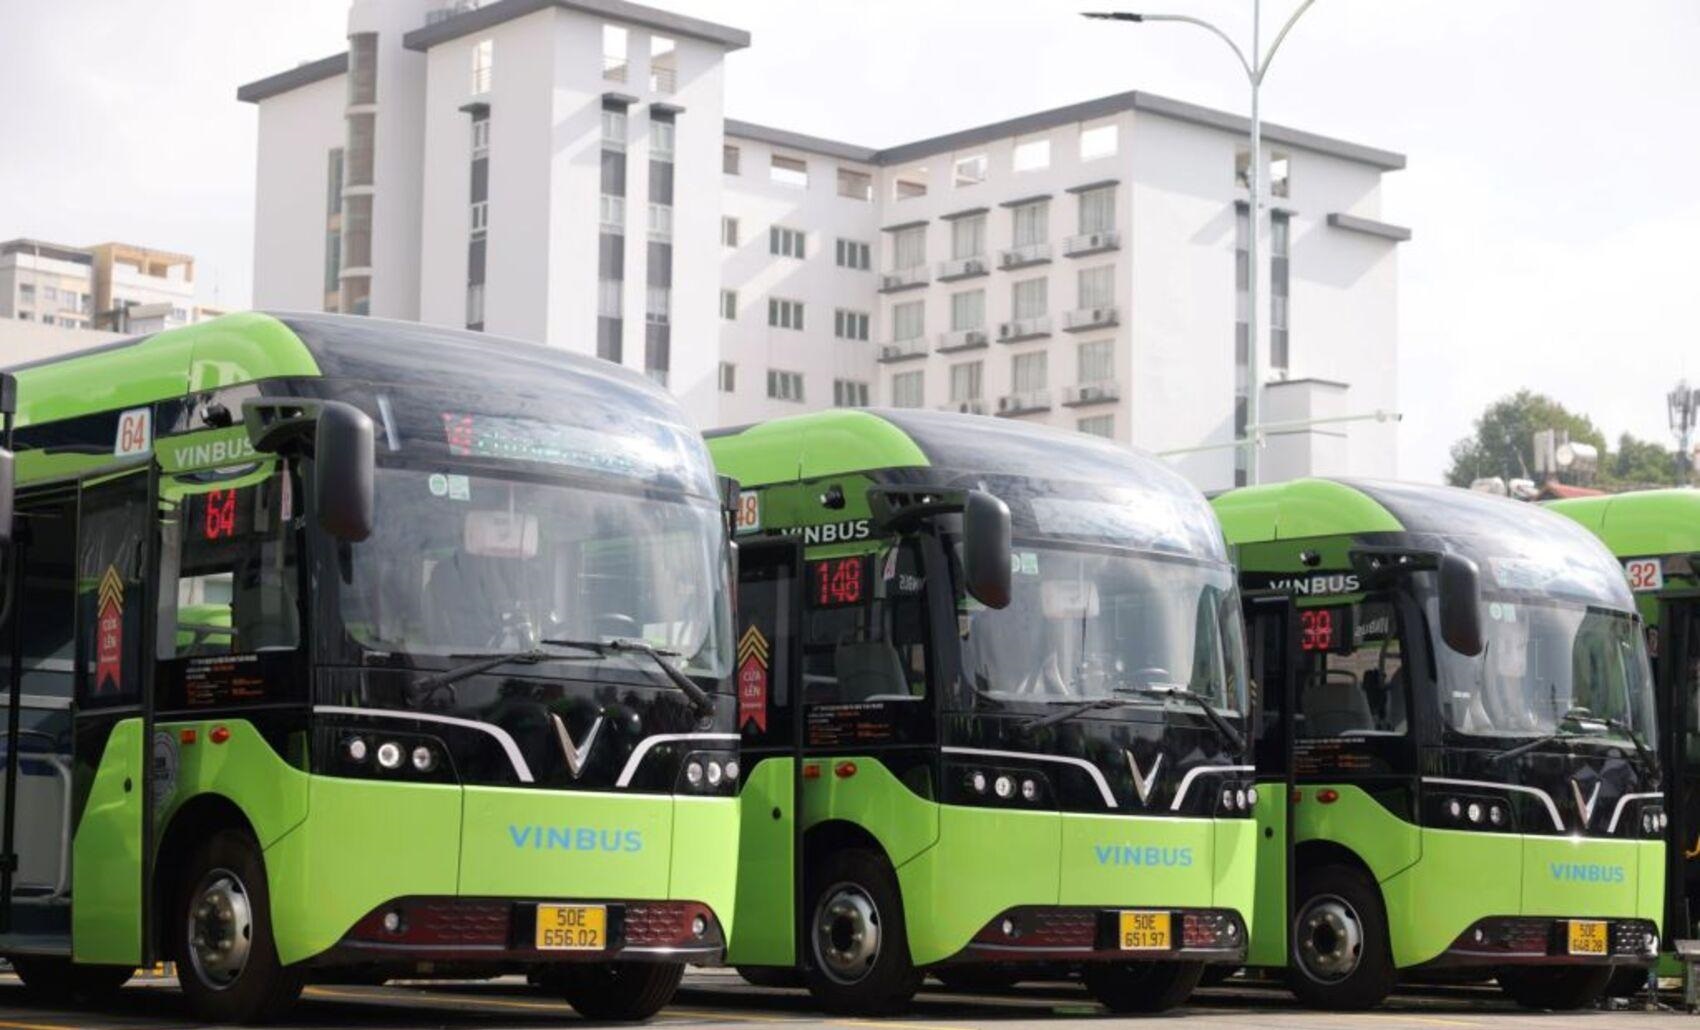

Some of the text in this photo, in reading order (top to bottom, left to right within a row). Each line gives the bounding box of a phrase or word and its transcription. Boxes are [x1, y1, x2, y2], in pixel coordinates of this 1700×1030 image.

[122, 414, 145, 452] 64
[205, 487, 236, 539] 64
[818, 557, 860, 604] 148
[1630, 563, 1656, 587] 32
[509, 825, 643, 852] VINBUS
[1095, 845, 1193, 866] VINBUS
[1551, 863, 1625, 882] VINBUS
[557, 908, 585, 926] 50E
[544, 929, 598, 947] 656.02
